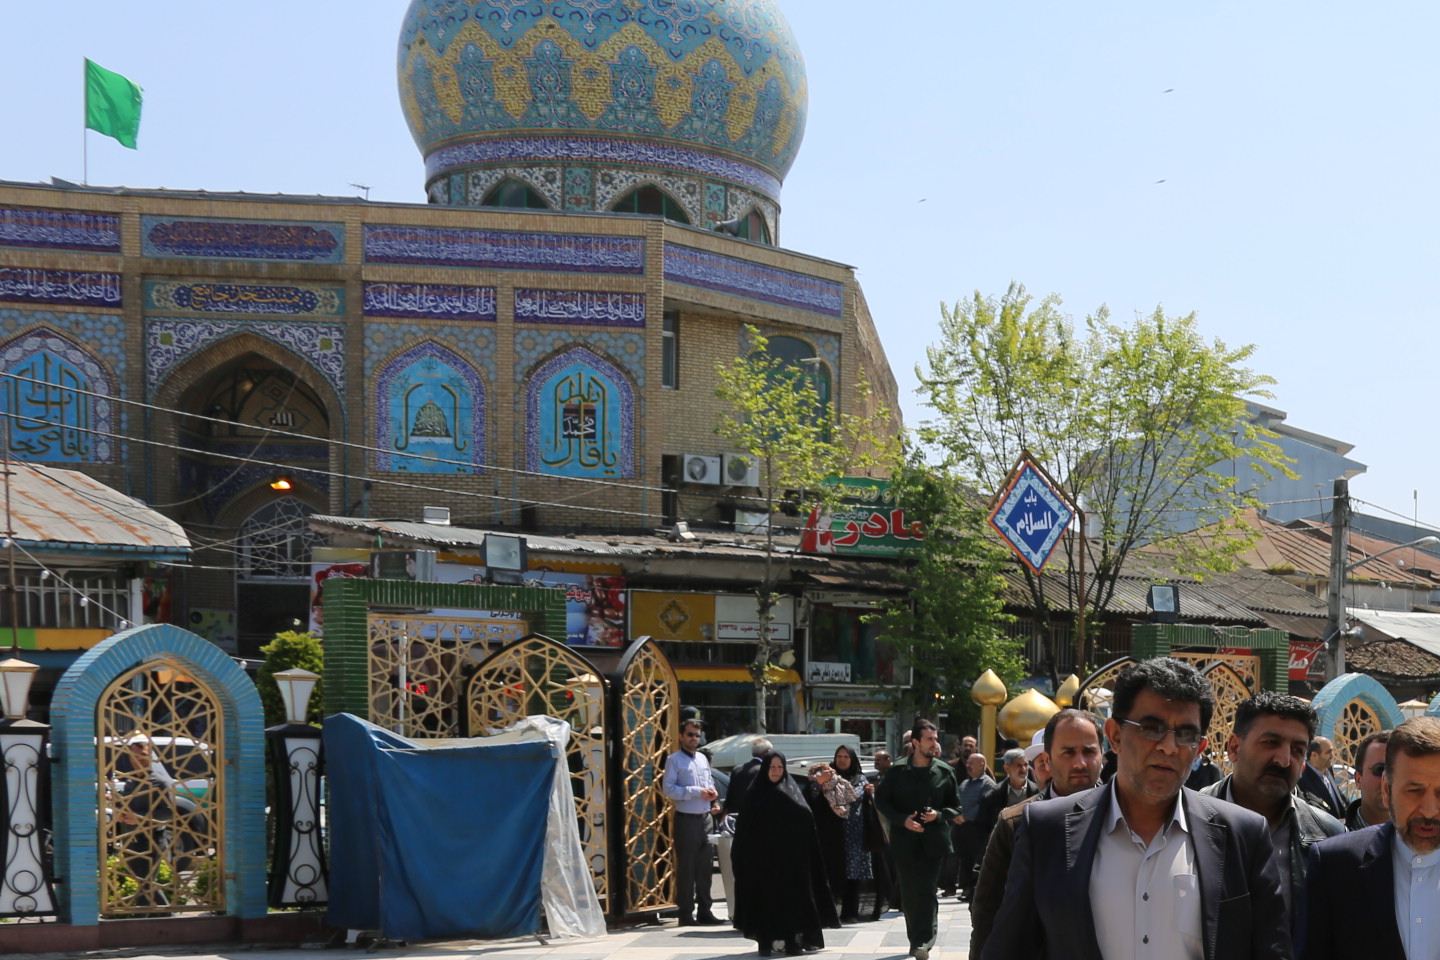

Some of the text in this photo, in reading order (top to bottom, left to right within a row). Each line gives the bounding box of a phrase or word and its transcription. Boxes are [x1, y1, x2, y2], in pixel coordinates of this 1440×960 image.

[234, 286, 300, 304] مسجد
[1024, 489, 1037, 507] باب
[1016, 510, 1053, 536] السلام
